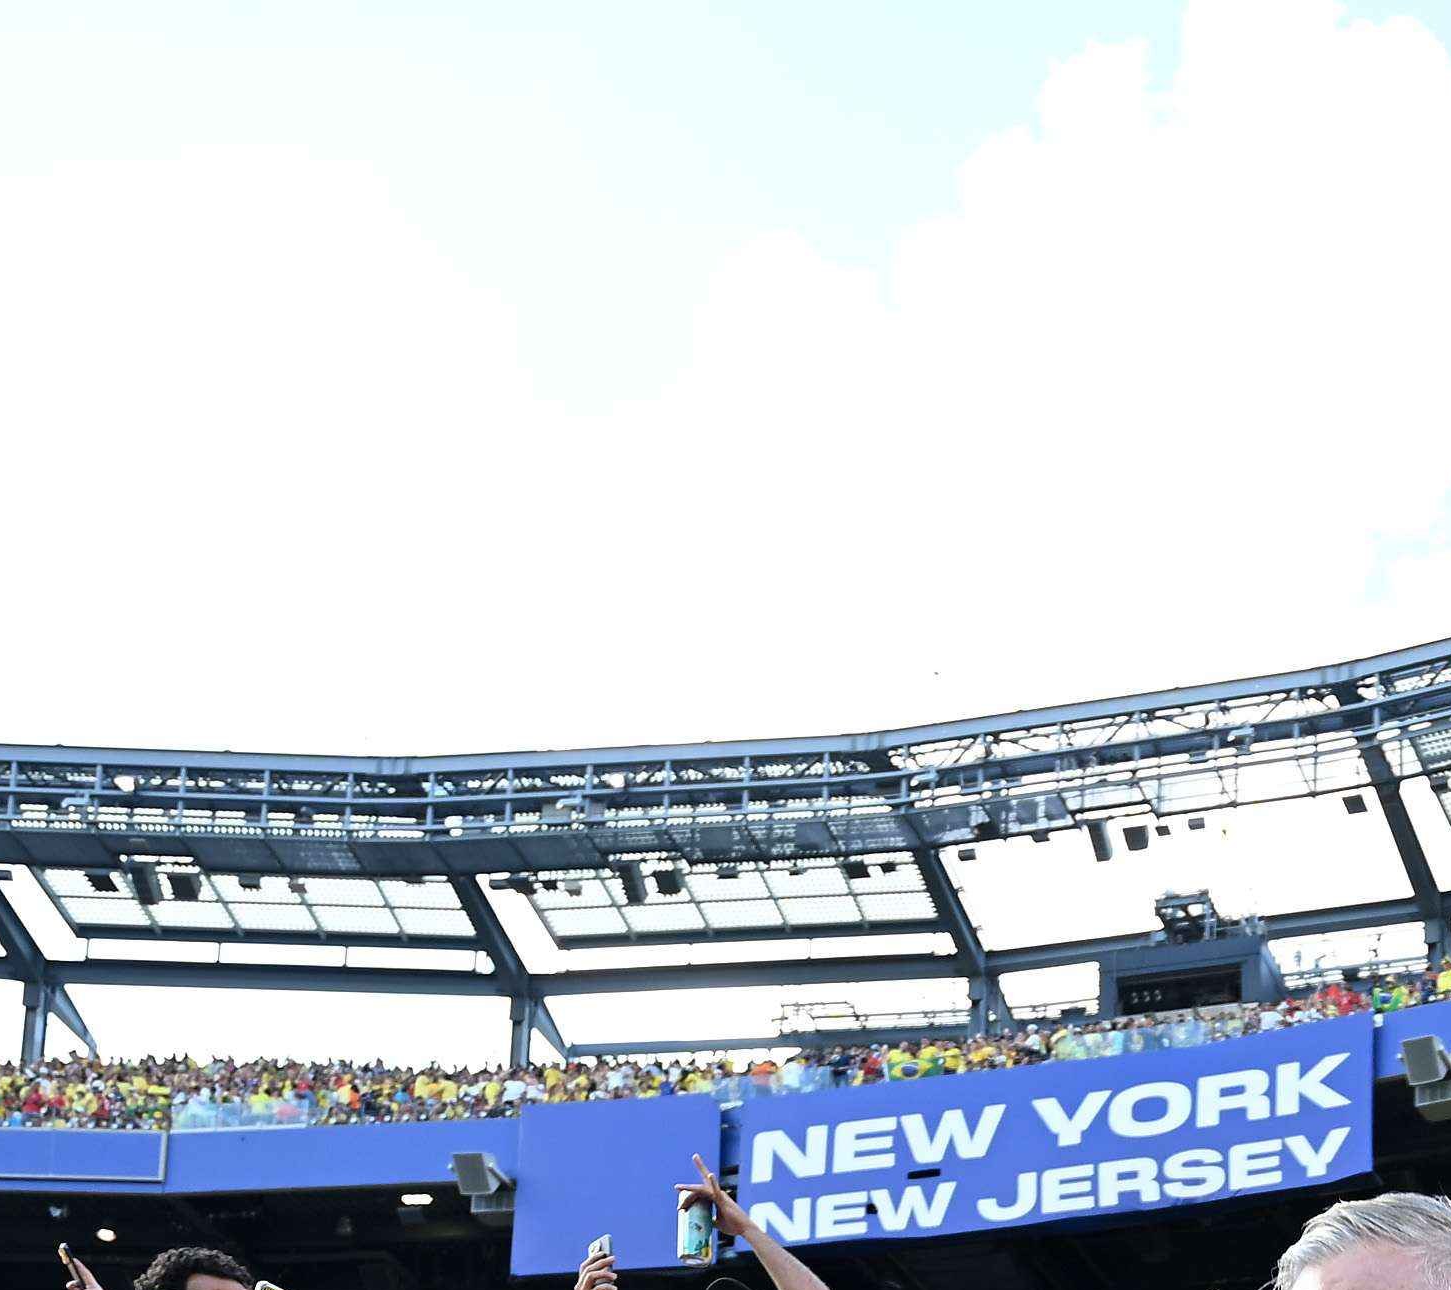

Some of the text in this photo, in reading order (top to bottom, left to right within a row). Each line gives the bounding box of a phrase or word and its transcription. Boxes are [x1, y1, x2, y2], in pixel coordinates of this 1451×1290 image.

[750, 1052, 1353, 1184] NEW YORK
[749, 1126, 1351, 1243] NEW JERSEY
